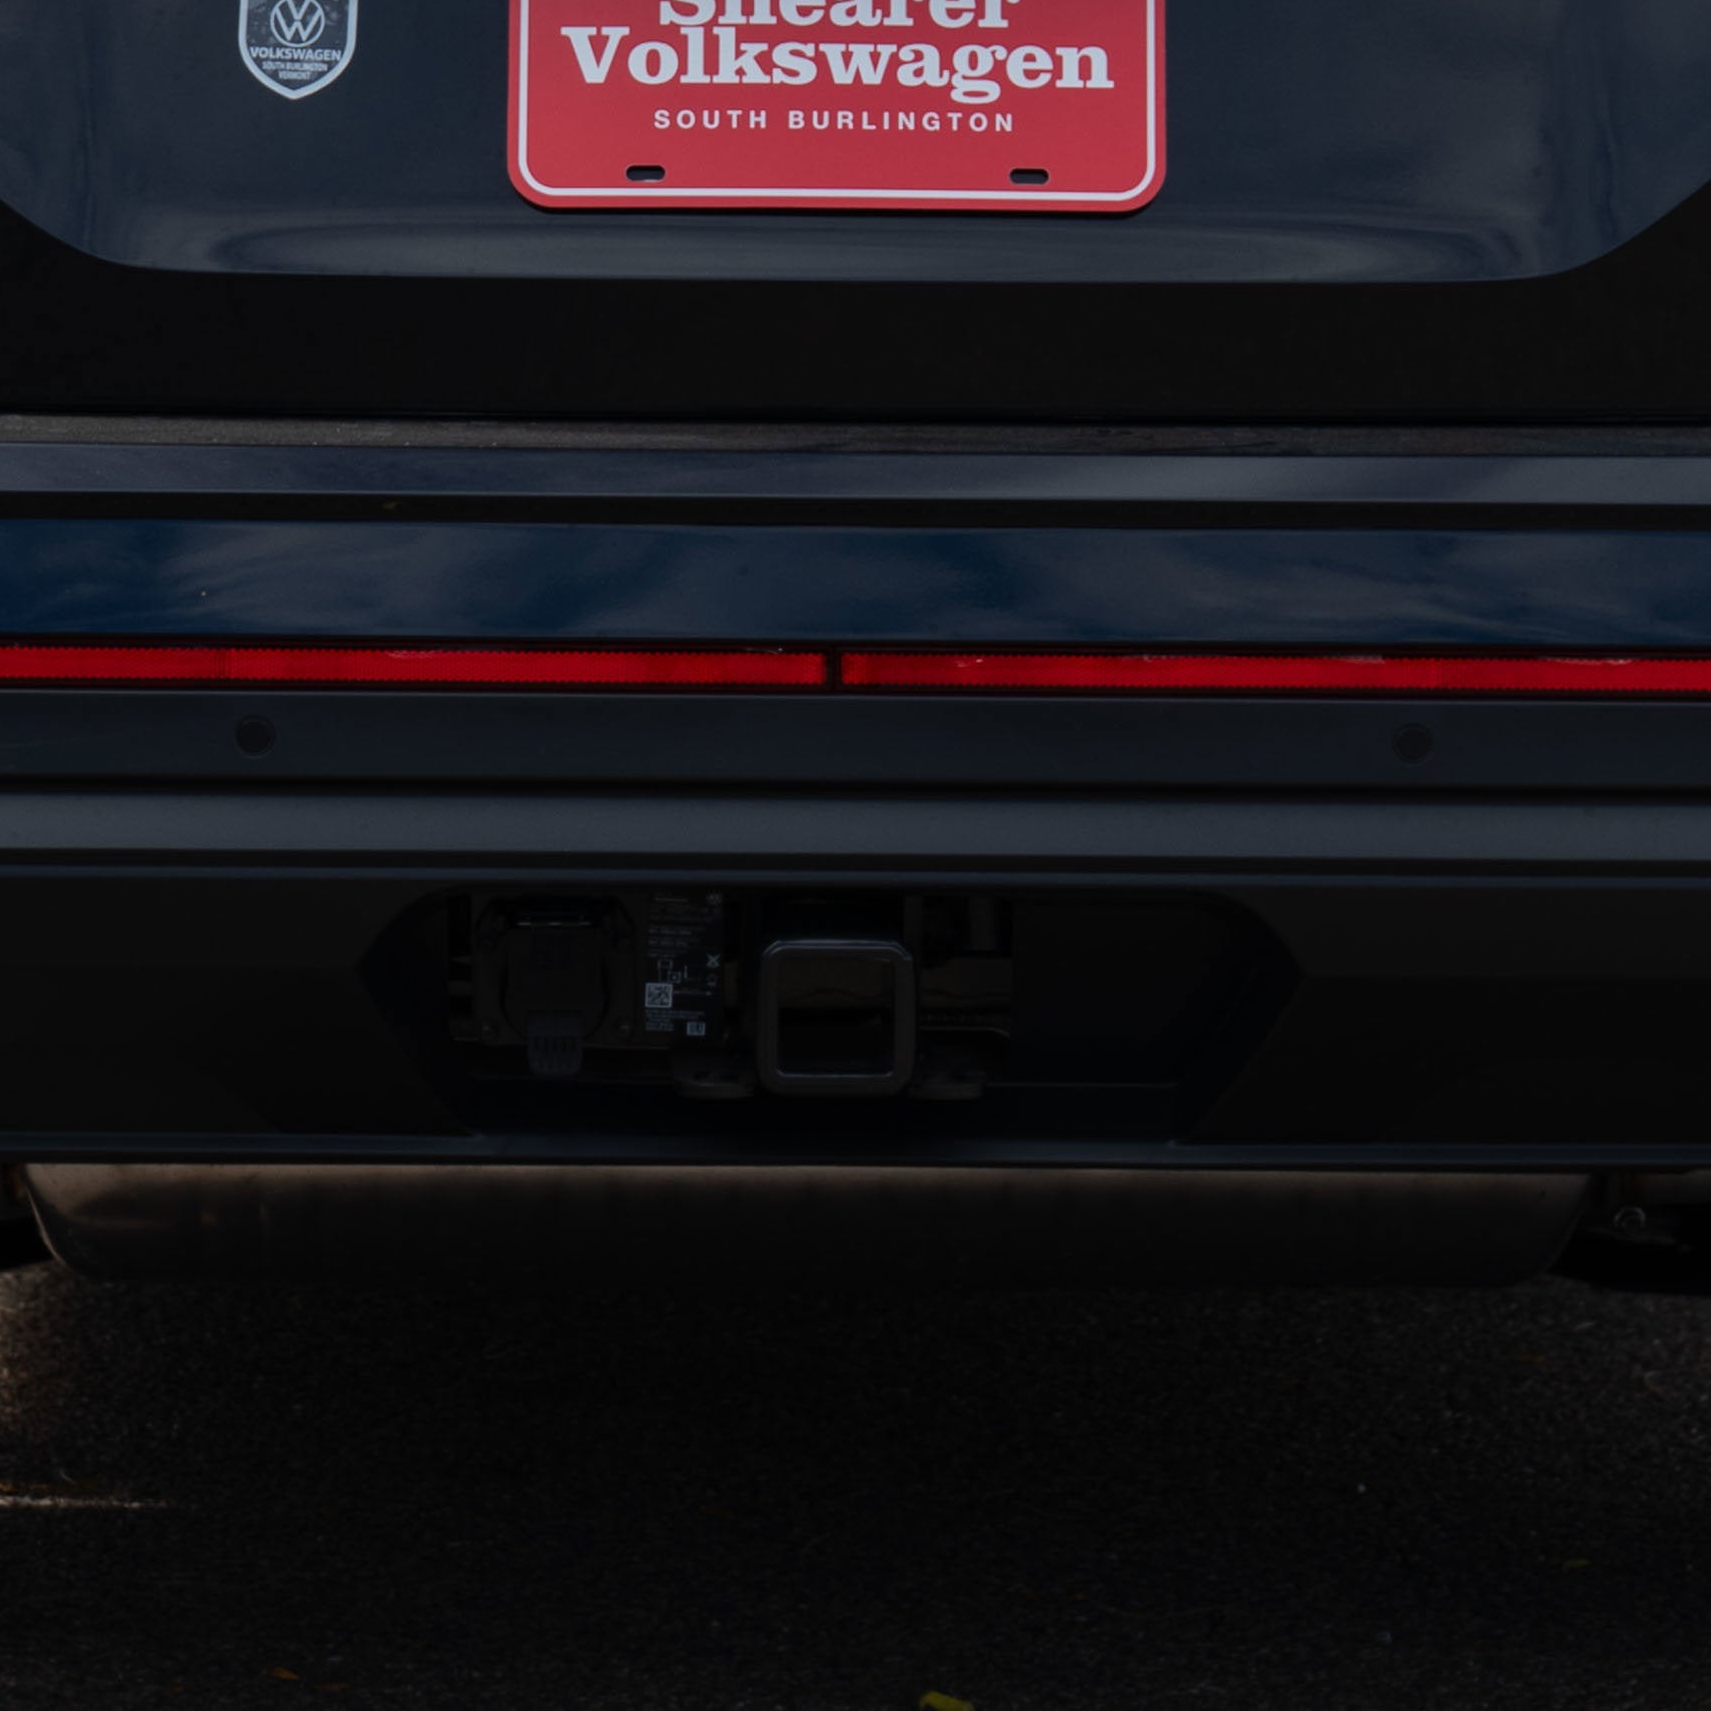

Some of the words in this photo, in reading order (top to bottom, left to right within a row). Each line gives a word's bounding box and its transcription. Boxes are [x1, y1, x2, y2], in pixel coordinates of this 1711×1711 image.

[249, 46, 342, 62] VOLKSWAGEN
[560, 25, 1115, 105] Volkswagen
[653, 108, 768, 131] SOUTH
[787, 110, 1015, 133] BURLINGTON
